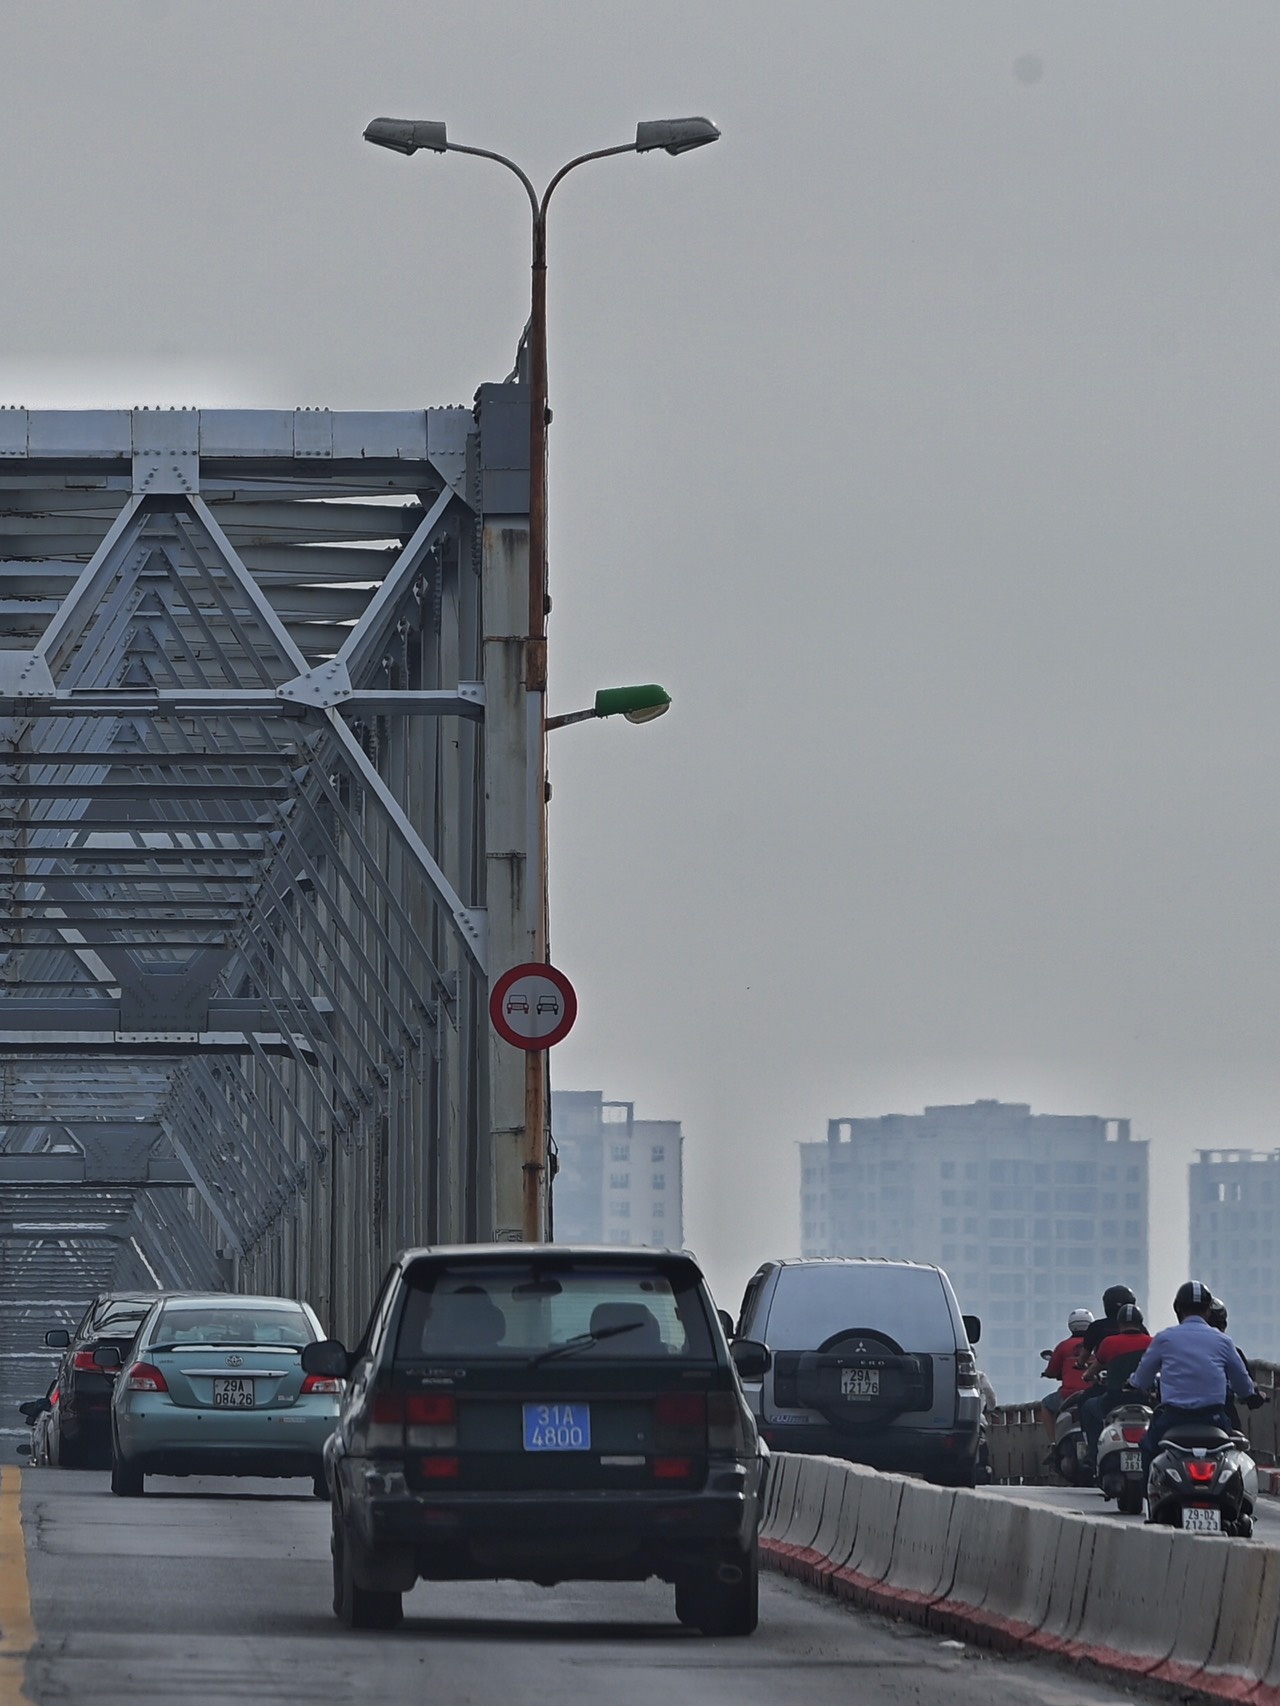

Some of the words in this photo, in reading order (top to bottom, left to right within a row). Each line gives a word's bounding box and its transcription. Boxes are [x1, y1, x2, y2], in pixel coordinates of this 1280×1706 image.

[850, 1369, 870, 1382] 29A
[223, 1380, 245, 1392] 29A
[215, 1392, 253, 1405] 084.26
[537, 1405, 574, 1425] 31A
[532, 1426, 583, 1447] 4800
